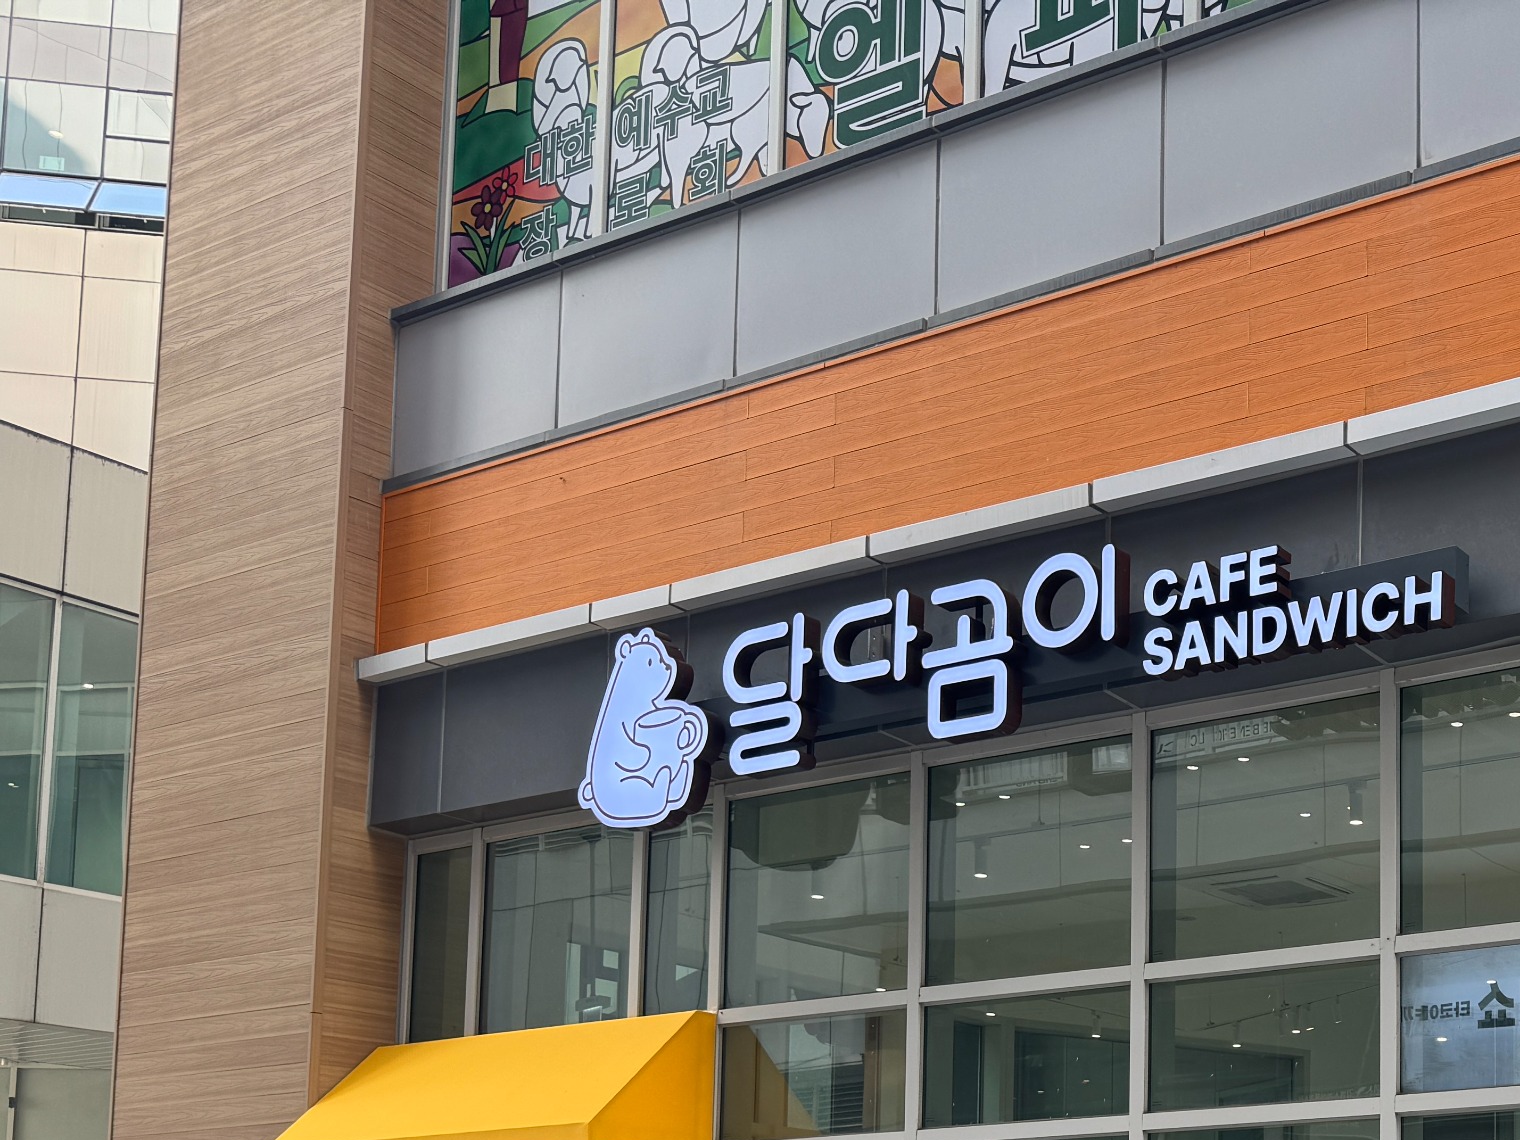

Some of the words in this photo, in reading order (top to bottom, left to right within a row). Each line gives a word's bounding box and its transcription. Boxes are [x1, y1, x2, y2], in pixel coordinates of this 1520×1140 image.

[614, 65, 733, 152] 예수교
[1142, 571, 1444, 676] SANDWICH
[1143, 545, 1280, 618] CAFE
[721, 544, 1119, 776] 달다곰이
